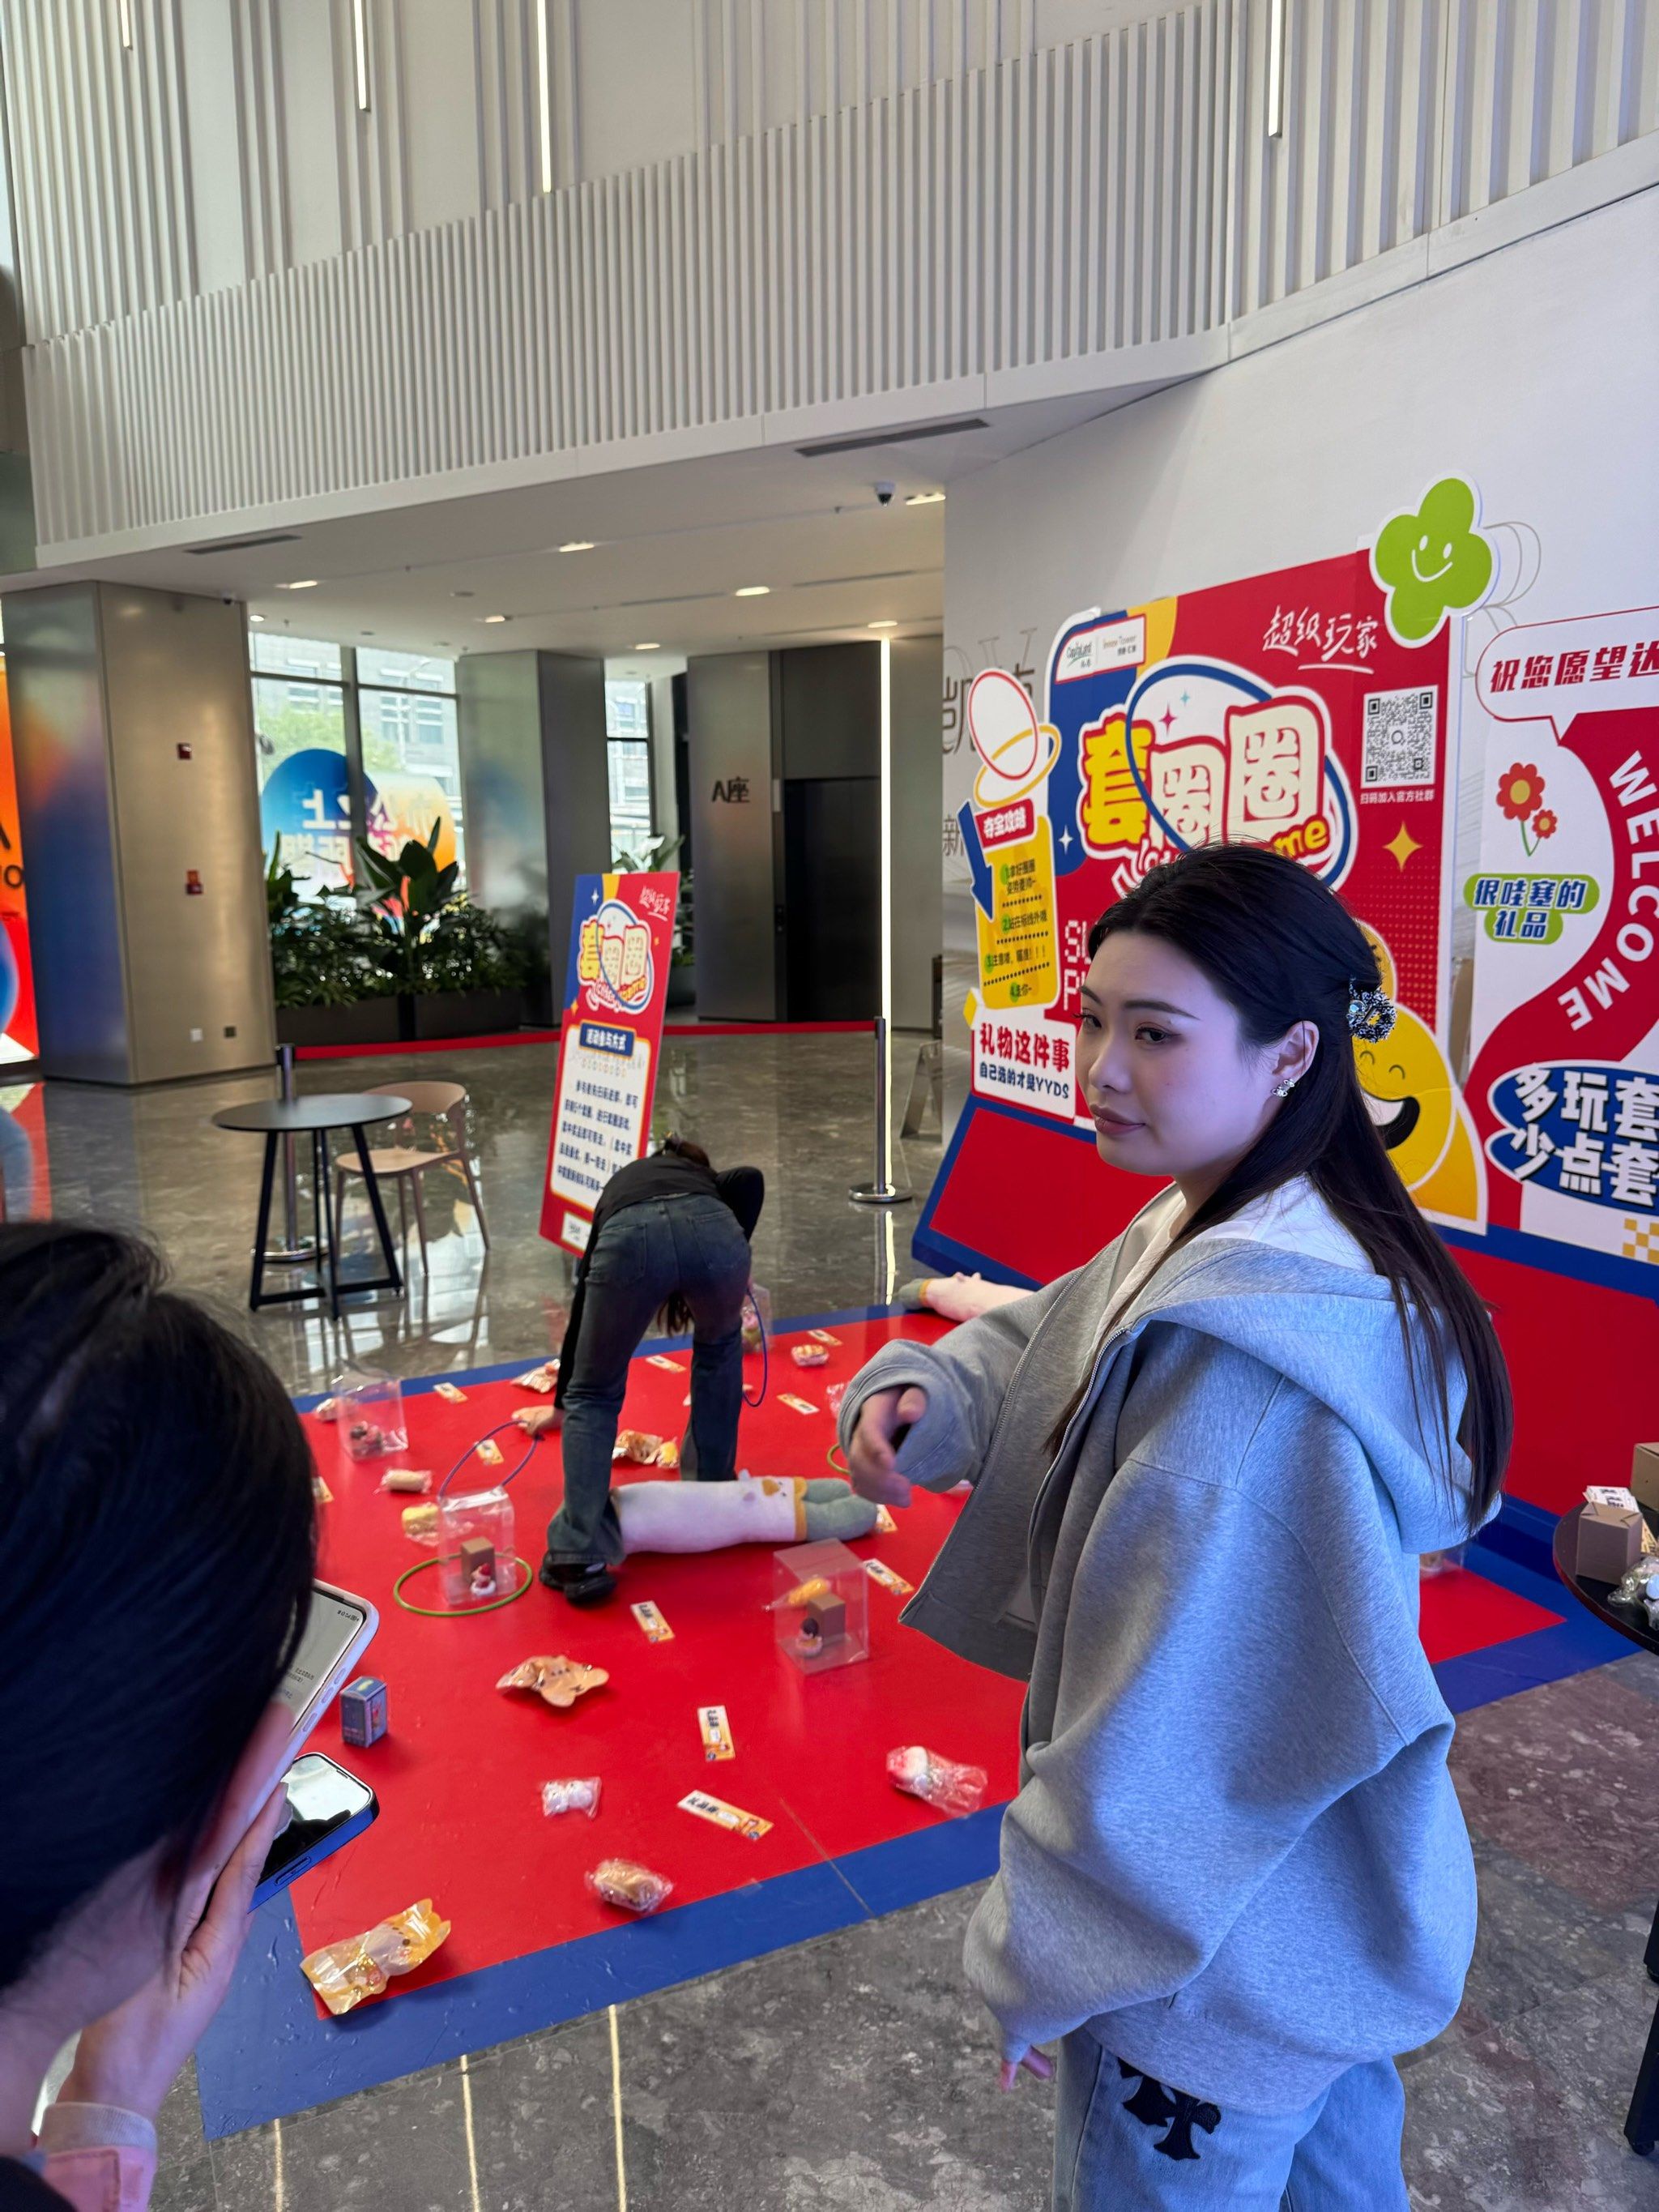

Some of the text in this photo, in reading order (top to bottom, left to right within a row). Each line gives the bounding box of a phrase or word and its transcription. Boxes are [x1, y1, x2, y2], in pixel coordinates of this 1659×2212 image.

[1262, 604, 1378, 662] 超级玩家
[1083, 702, 1322, 848] 套圈圈
[1360, 789, 1435, 805] 扫码加入官方社群
[983, 805, 1027, 839] 夺宝攻略
[1473, 878, 1587, 910] 很哇塞的
[1557, 749, 1659, 1031] WELCOME
[1494, 909, 1549, 939] 礼品
[979, 1022, 1070, 1073] 礼物这件事
[979, 1061, 1069, 1099] 自己选的才是YYDS
[1514, 1068, 1659, 1142] 多玩套
[1509, 1123, 1659, 1207] 少点套
